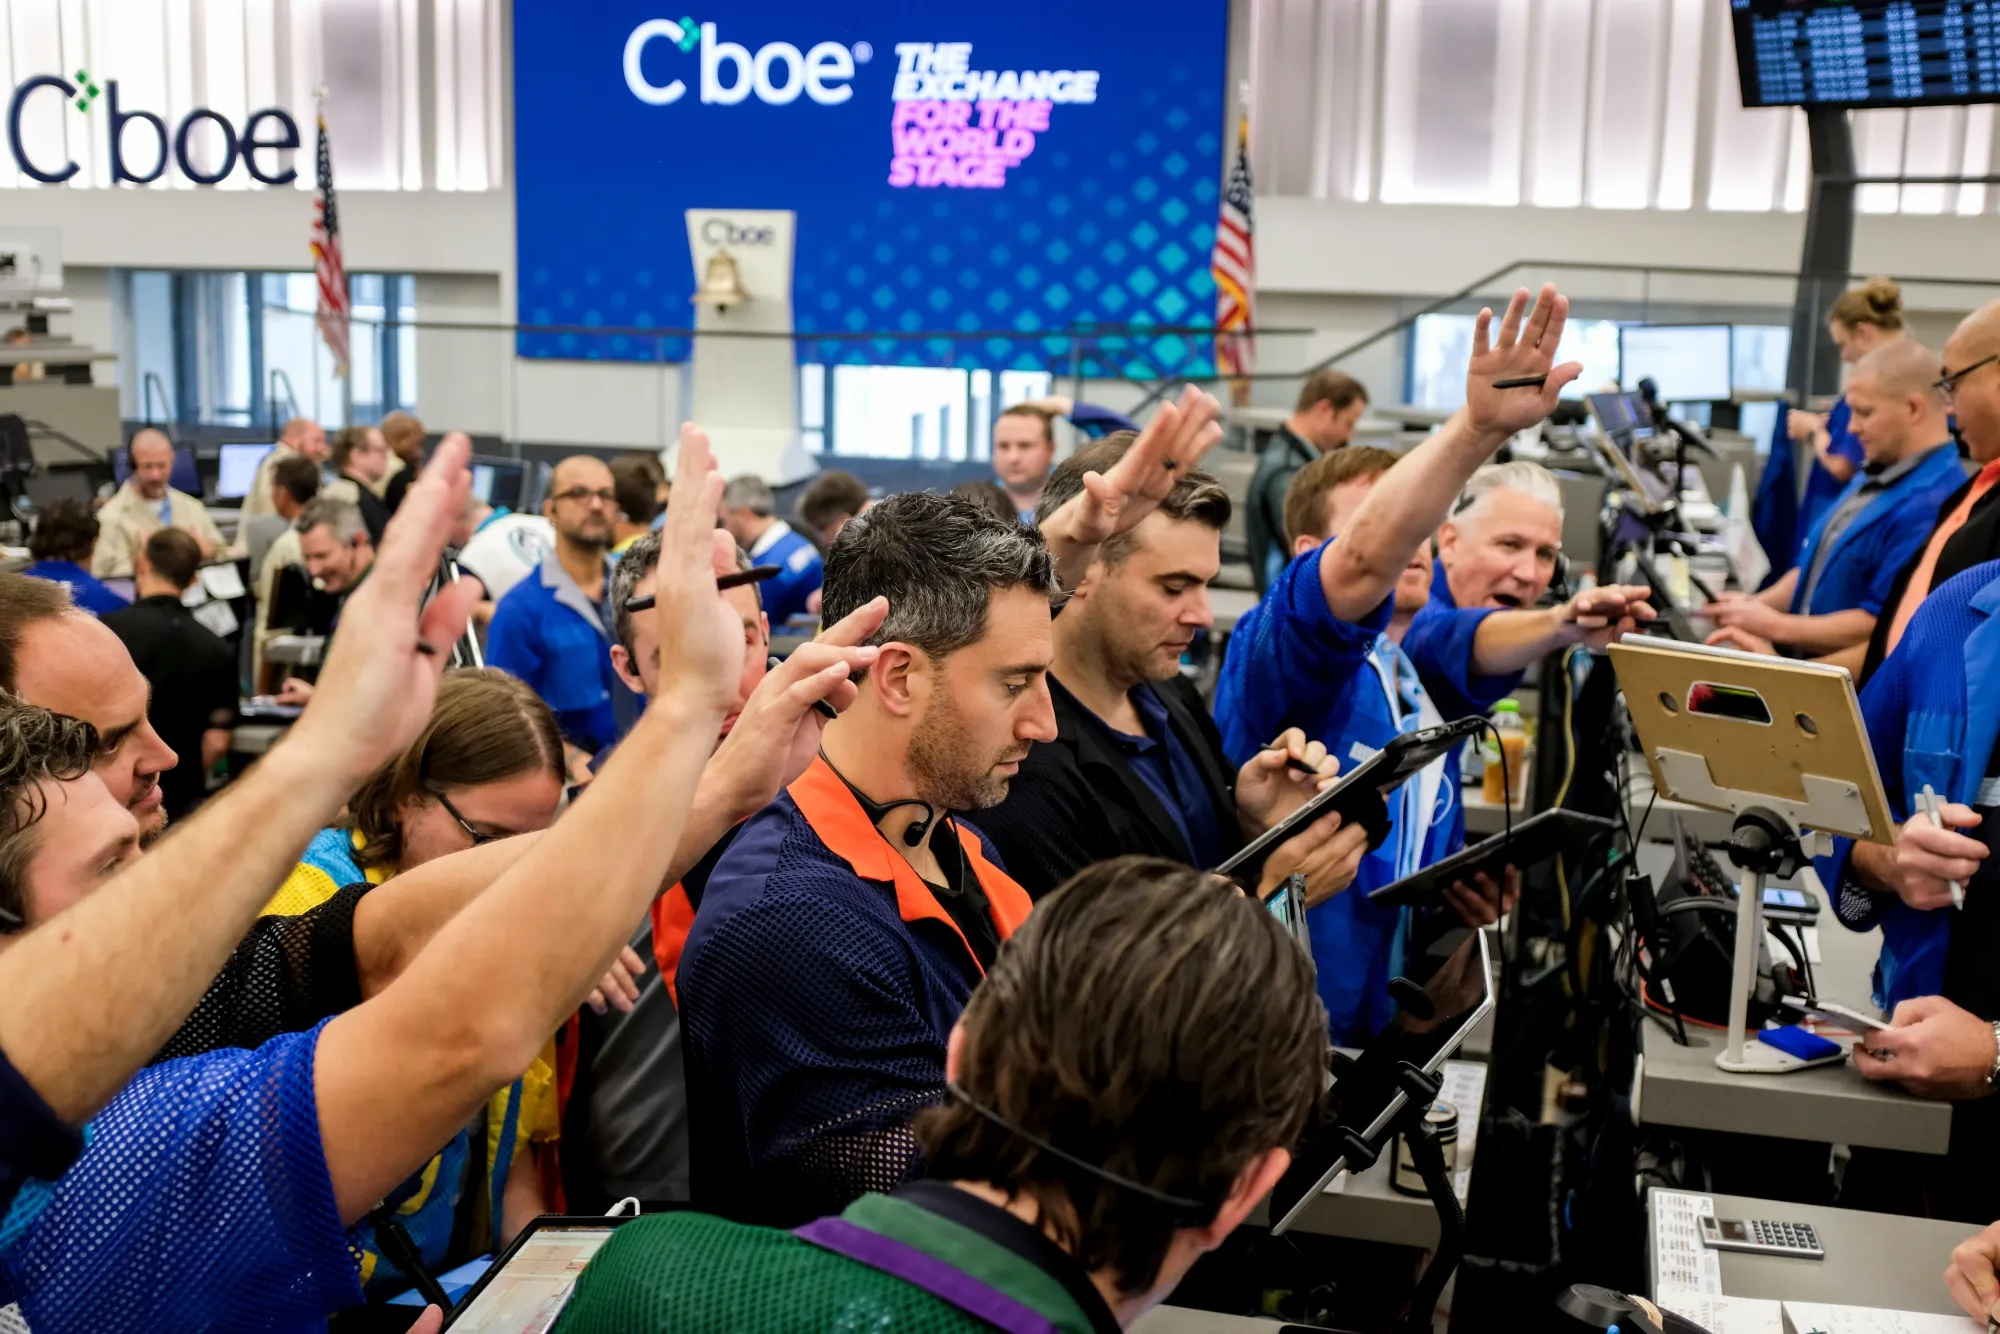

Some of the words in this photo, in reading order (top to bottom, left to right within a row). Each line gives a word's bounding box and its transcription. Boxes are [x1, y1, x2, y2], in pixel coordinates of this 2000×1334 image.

[895, 42, 972, 72] THE
[892, 71, 1099, 103] EXCHANGE
[7, 74, 300, 184] Cboe
[893, 101, 972, 130] FOR
[976, 101, 1052, 131] THE
[892, 128, 1035, 157] WORLD
[701, 217, 775, 246] Cboe
